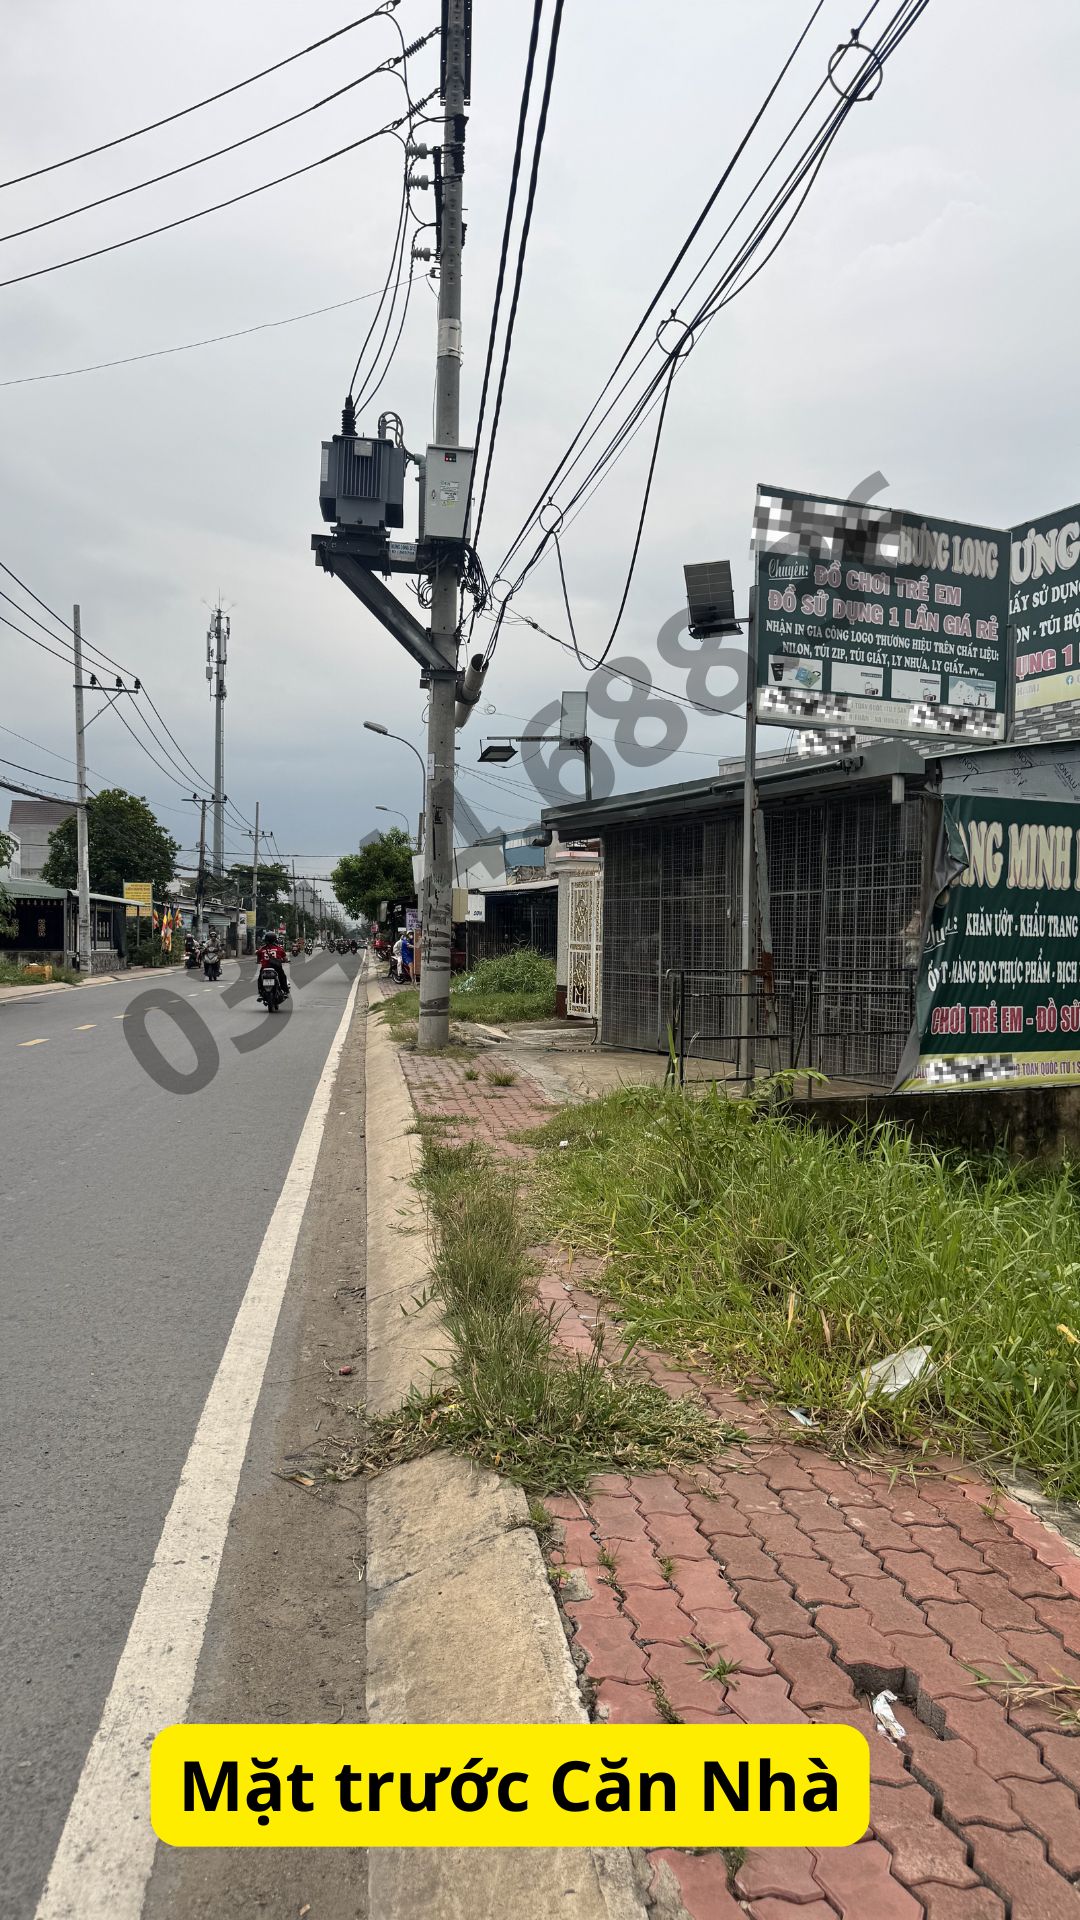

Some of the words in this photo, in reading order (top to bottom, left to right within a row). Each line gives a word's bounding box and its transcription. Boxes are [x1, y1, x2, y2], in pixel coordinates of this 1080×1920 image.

[951, 535, 999, 580] LONG
[814, 560, 842, 588] ĐỒ
[846, 569, 890, 596] CHƠI
[894, 574, 930, 601] TRẺ
[934, 583, 962, 607] EM
[1031, 583, 1049, 608] SỬ
[1051, 579, 1080, 604] DỤN
[768, 583, 797, 613] ĐỒ
[801, 589, 829, 617] SỬ
[832, 598, 884, 625] DỤNG
[889, 606, 900, 627] 1
[904, 603, 940, 633] LẦN
[943, 613, 972, 638] GIÁ
[975, 614, 999, 641] RẺ
[1039, 614, 1061, 638] TÚI
[765, 618, 793, 637] NHẬN
[794, 623, 805, 636] IN
[806, 625, 823, 638] GIA
[825, 624, 849, 641] CÔNG
[850, 630, 874, 644] LOGO
[875, 633, 911, 649] THƯƠNG
[911, 636, 932, 654] HIỆU
[933, 639, 955, 655] TRÊN
[956, 641, 979, 658] CHẤT
[782, 641, 812, 658] NILON,
[814, 643, 830, 658] TÚI
[831, 647, 848, 662] ZIP,
[849, 648, 865, 663] TÚI
[866, 648, 890, 668] GIẤY,
[891, 654, 903, 667] LY
[903, 656, 930, 673] NHỰA,
[931, 659, 943, 672] LY
[1061, 643, 1073, 667] 1
[1006, 823, 1073, 890] MINH
[965, 906, 993, 936] KHĂN
[1019, 901, 1045, 937] KHẨU
[1047, 914, 1079, 938] TRANG
[978, 960, 997, 990] BỌC
[998, 957, 1023, 990] THỰC
[1024, 948, 1050, 984] PHẨM
[1056, 961, 1077, 990] BỊCH
[931, 1002, 966, 1034] CHƠI
[969, 1000, 998, 1034] TRẺ
[1001, 1005, 1023, 1033] EM
[1036, 997, 1057, 1032] ĐỒ
